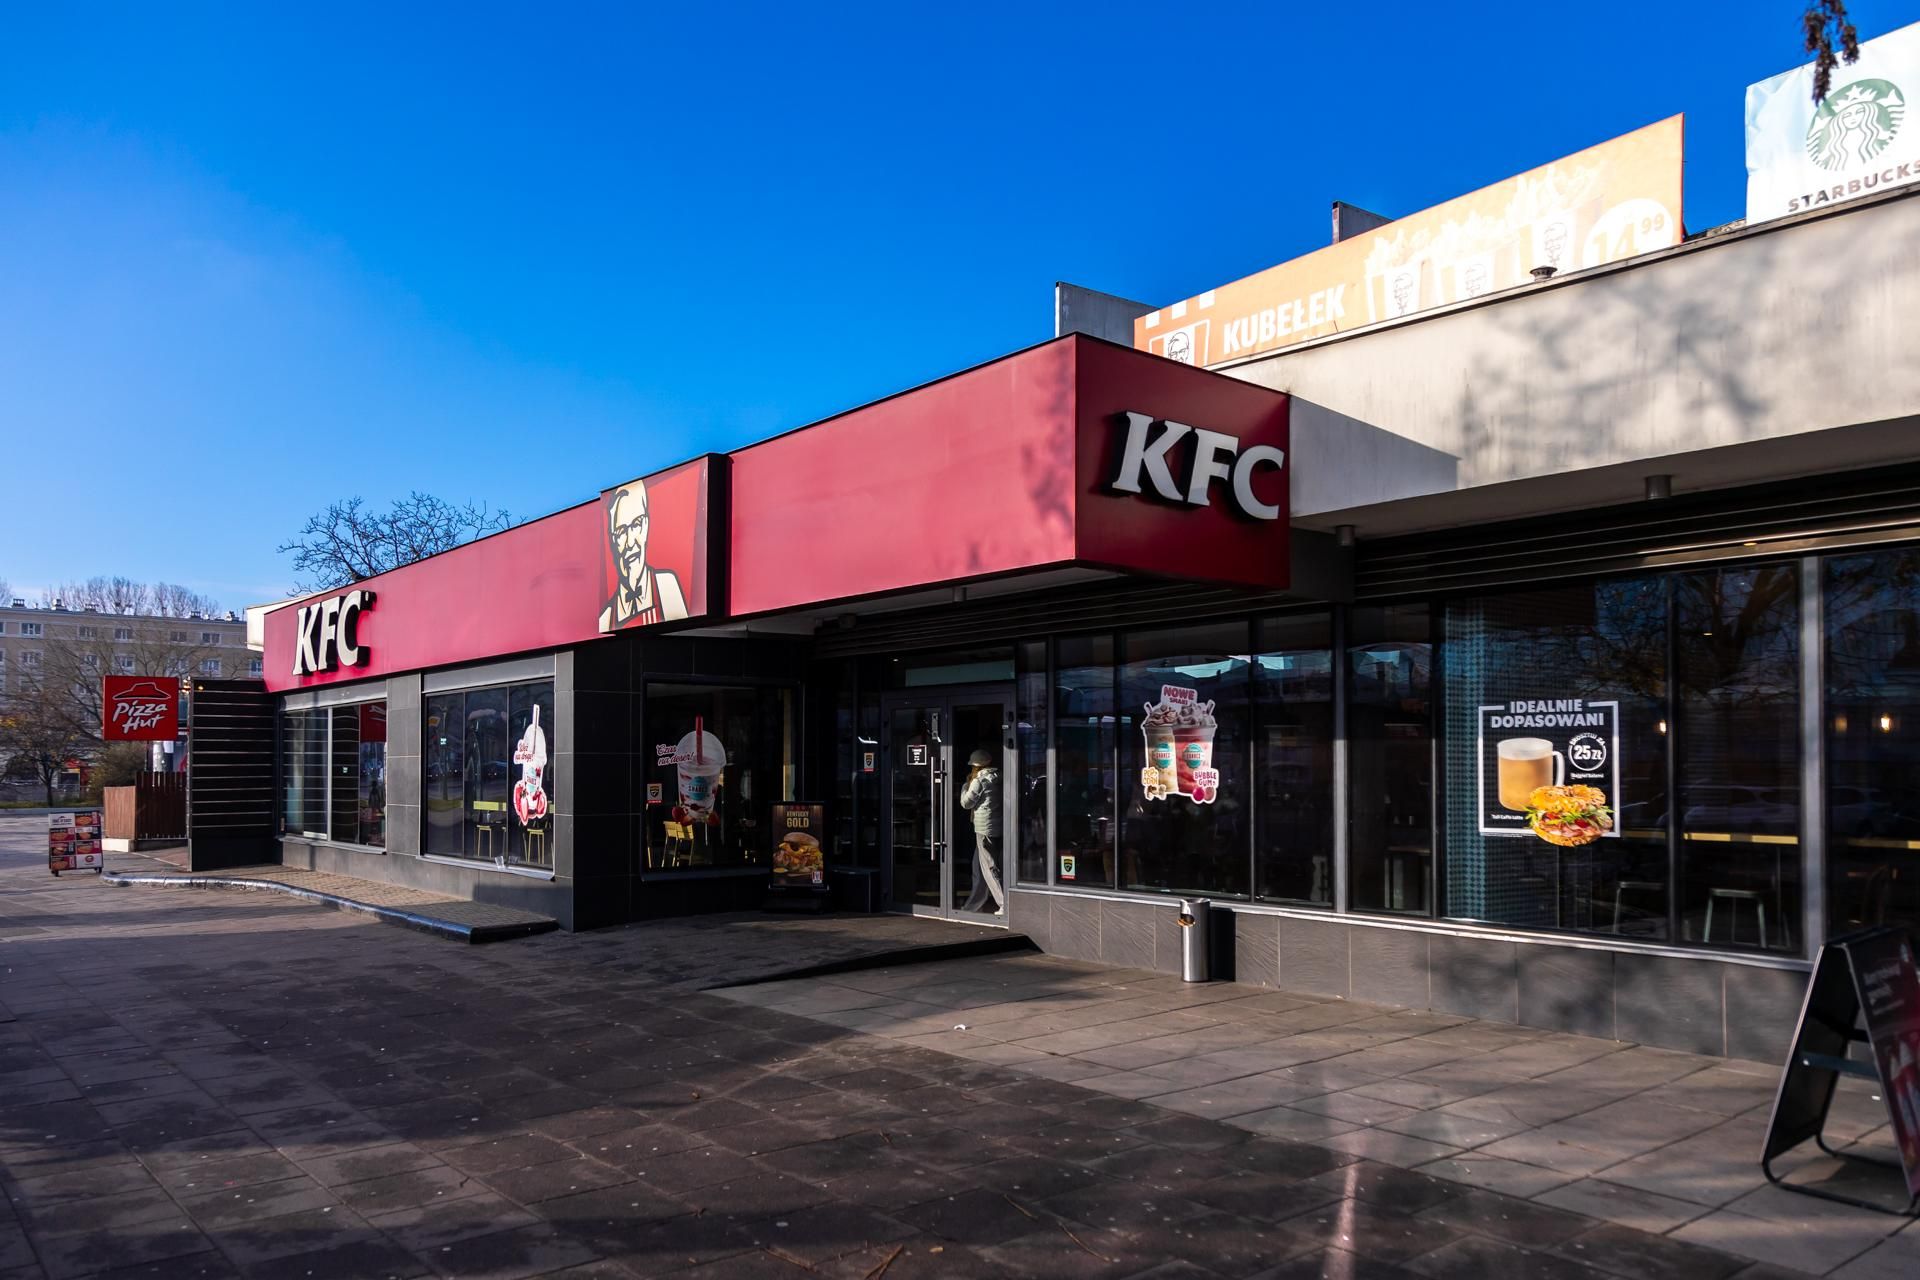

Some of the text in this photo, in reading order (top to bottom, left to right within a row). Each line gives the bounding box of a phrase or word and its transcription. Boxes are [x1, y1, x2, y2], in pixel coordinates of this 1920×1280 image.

[1223, 284, 1345, 355] KUBEŁEK
[1112, 411, 1285, 520] KFC
[293, 590, 362, 676] KFC
[1163, 686, 1195, 701] NOWE
[112, 700, 168, 723] Pizza
[1510, 699, 1583, 714] IDEALNIE
[122, 714, 166, 735] Hut
[1490, 712, 1605, 729] DOPASOWANI
[1573, 744, 1592, 761] 25
[786, 818, 810, 829] GOLD
